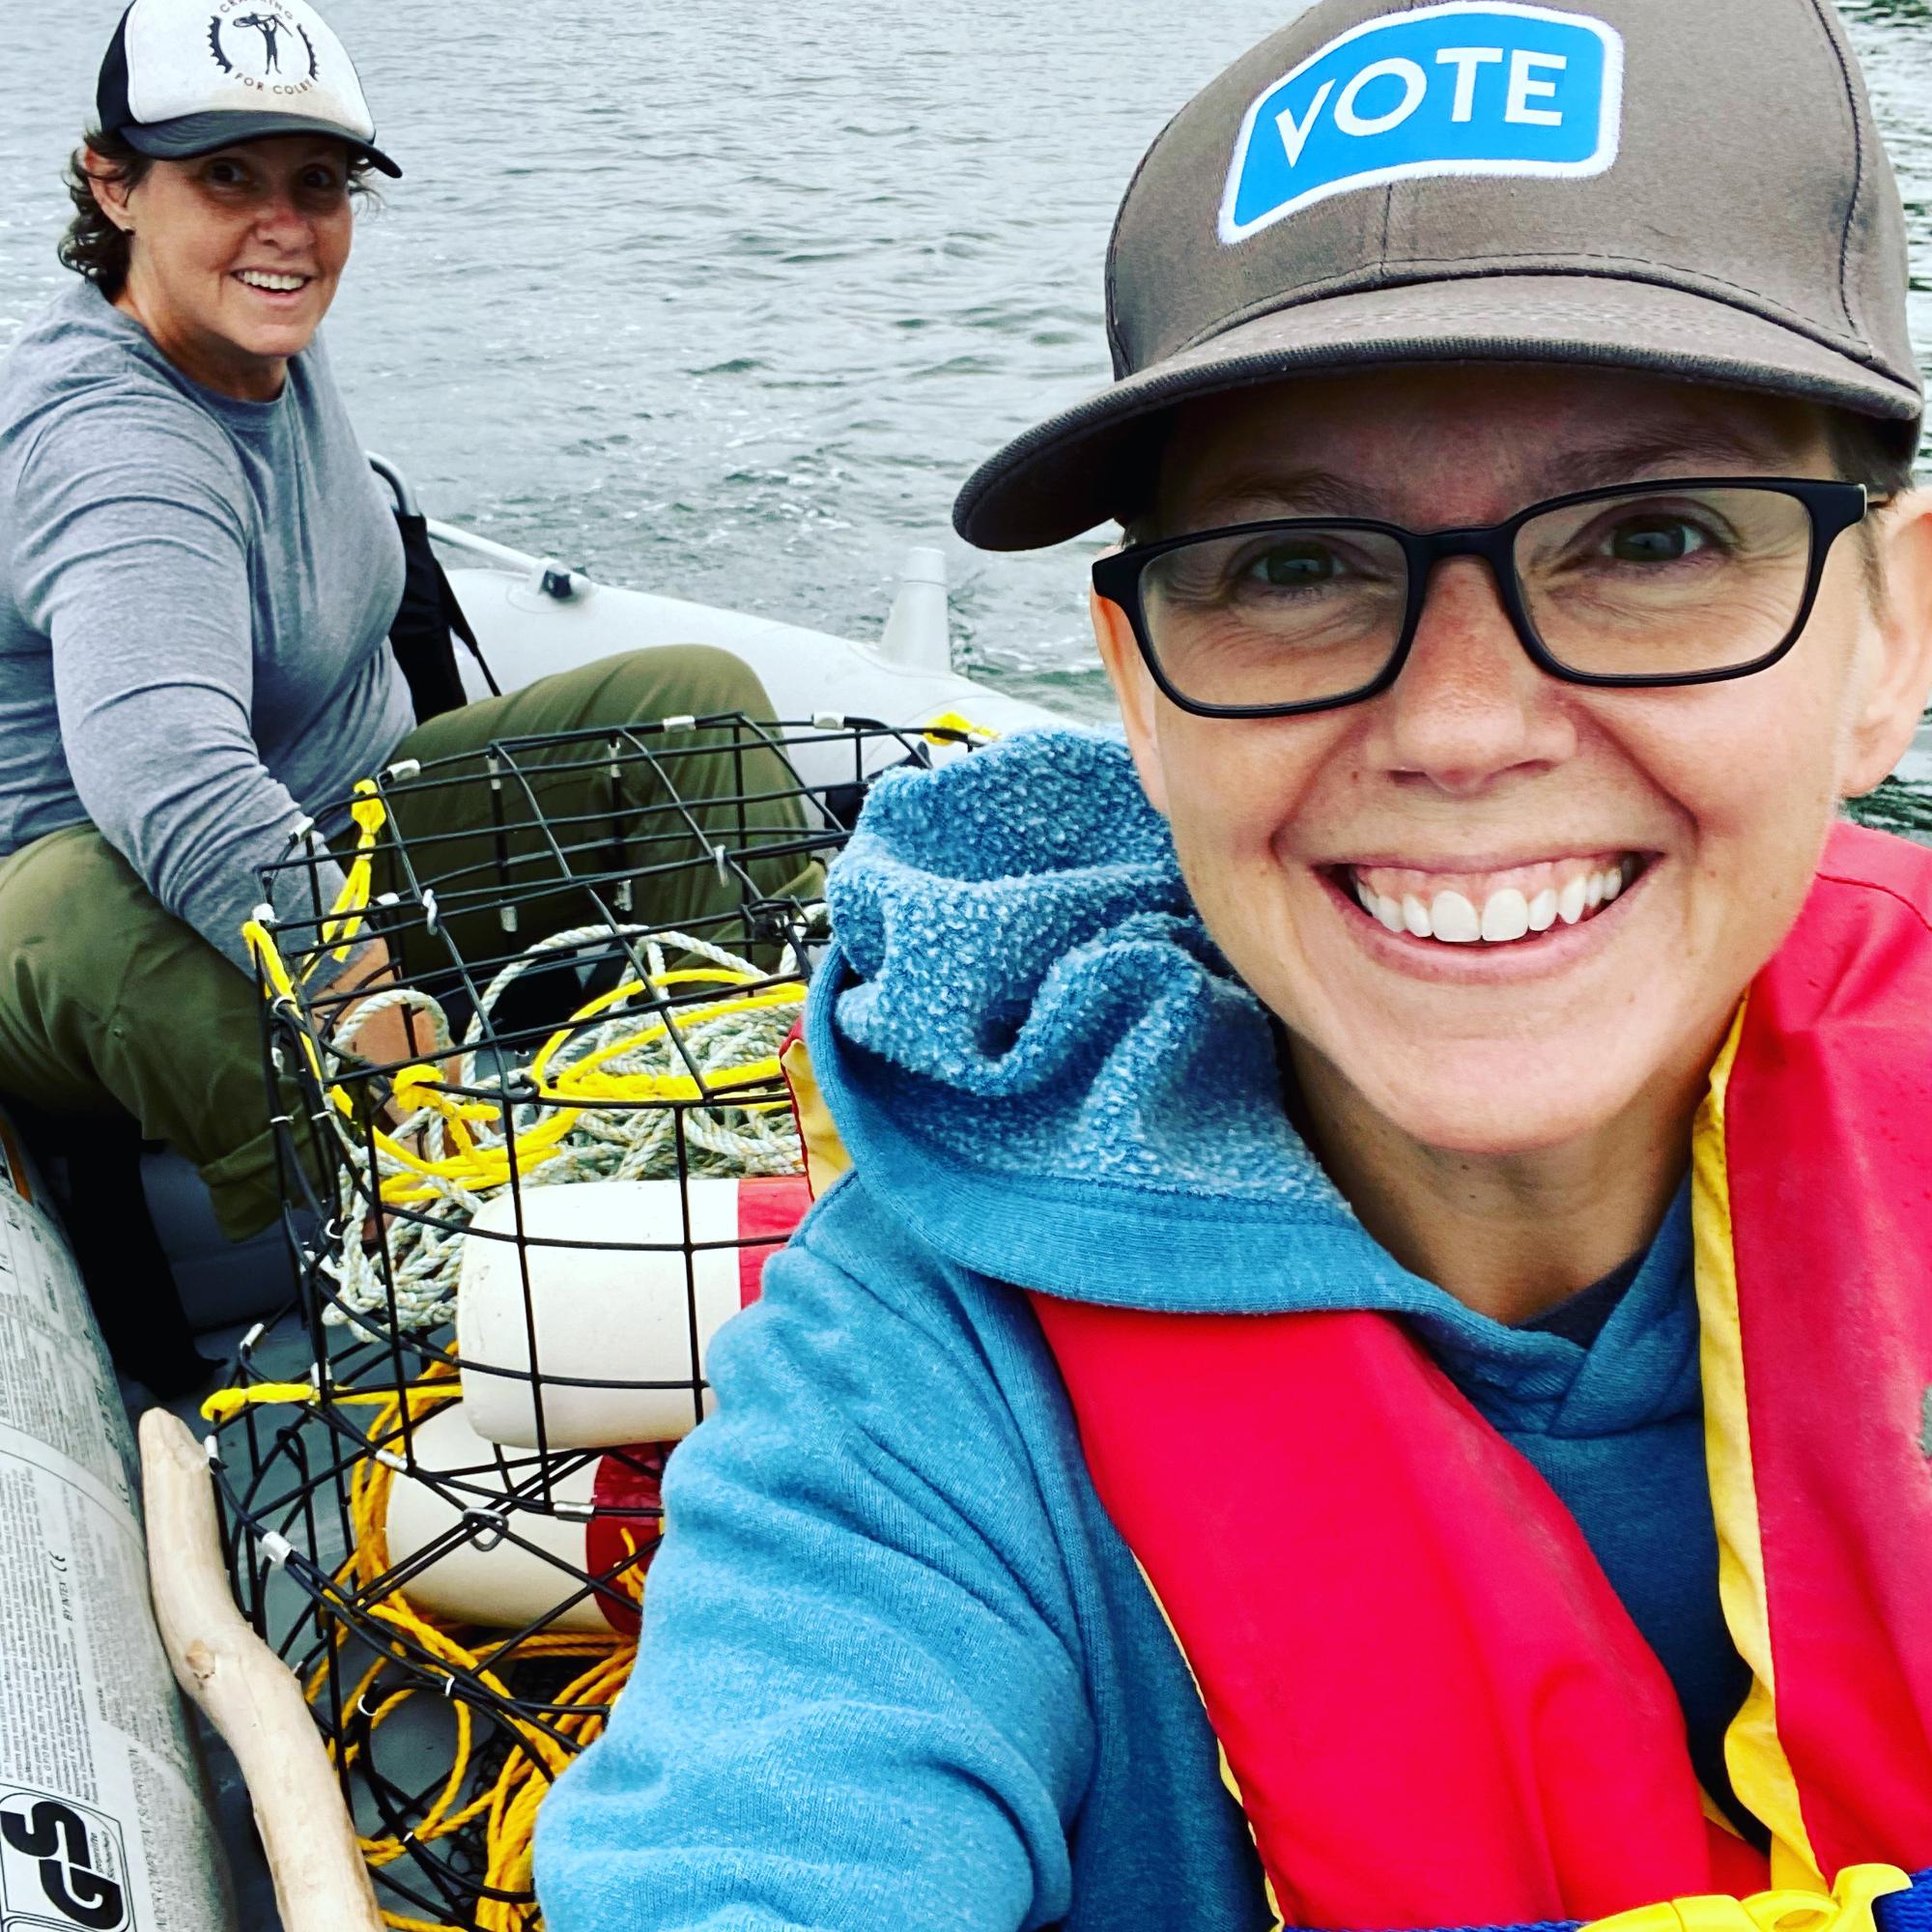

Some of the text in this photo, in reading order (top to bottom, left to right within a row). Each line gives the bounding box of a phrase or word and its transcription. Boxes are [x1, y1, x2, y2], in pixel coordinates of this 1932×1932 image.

[235, 72, 263, 92] FOR
[1274, 46, 1567, 169] VOTE
[0, 1802, 123, 1930] GS
